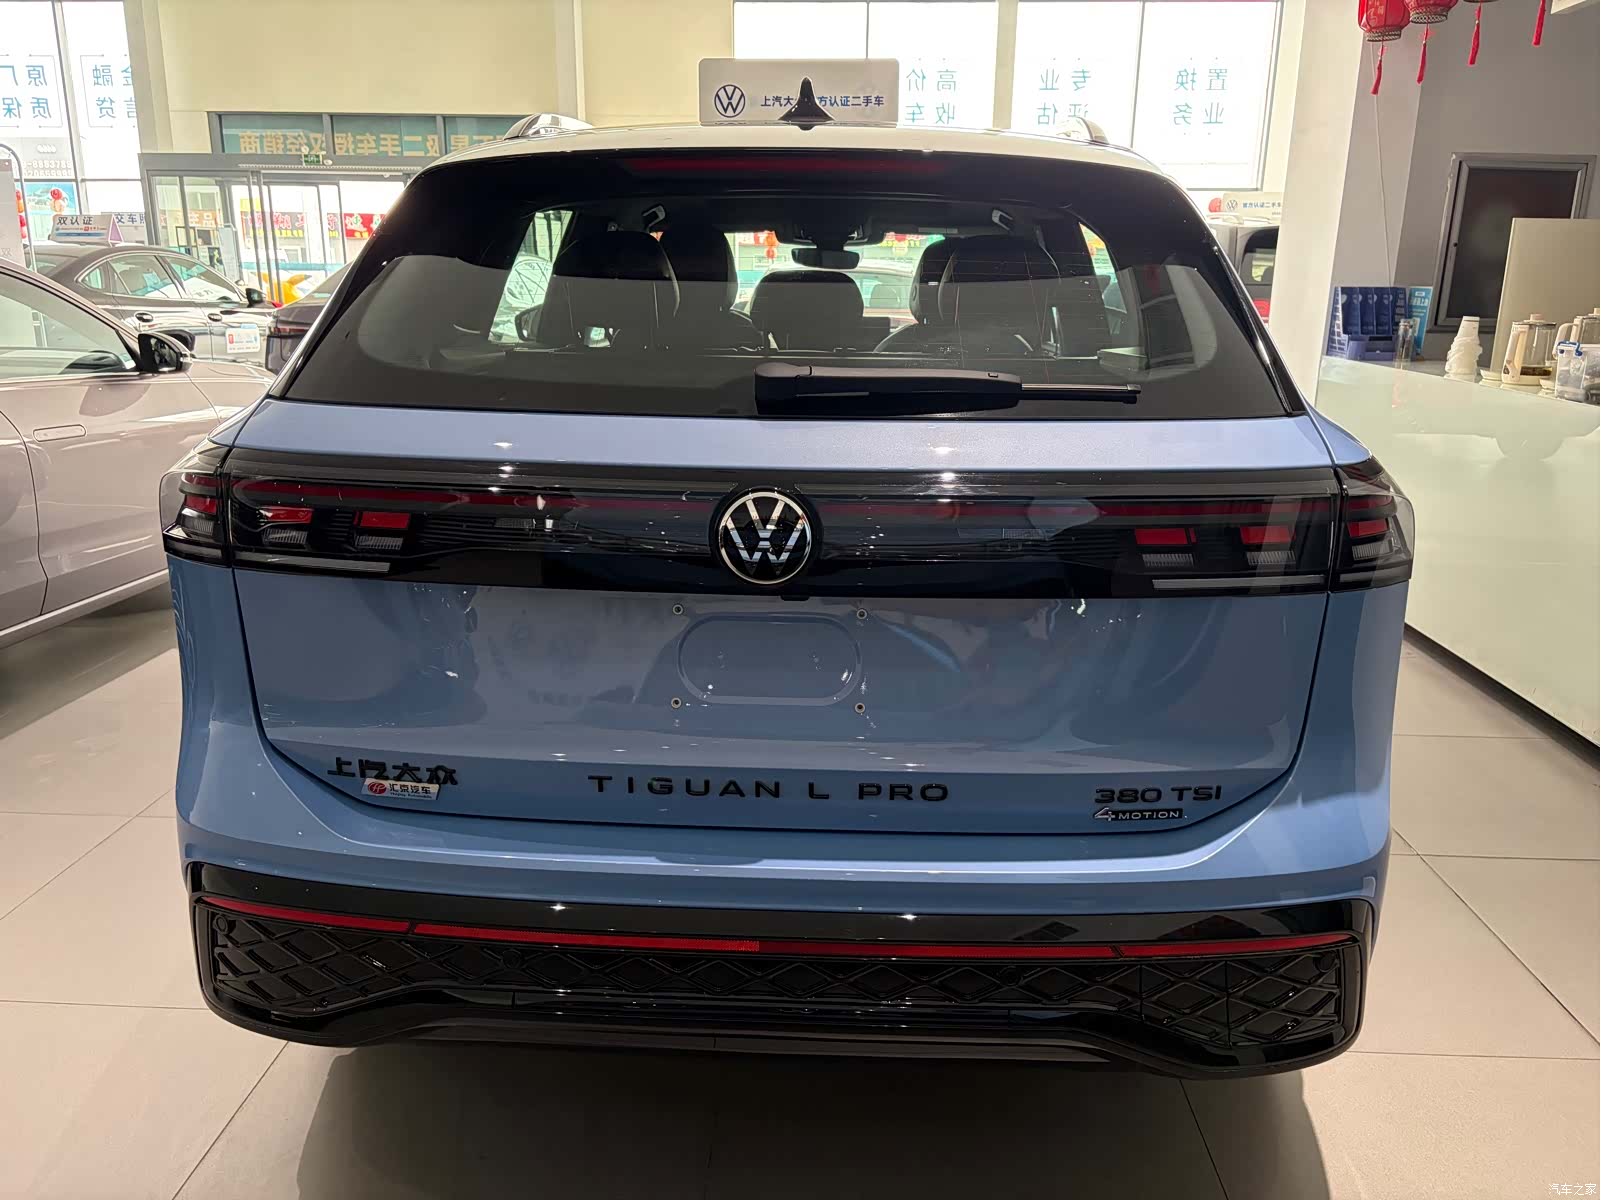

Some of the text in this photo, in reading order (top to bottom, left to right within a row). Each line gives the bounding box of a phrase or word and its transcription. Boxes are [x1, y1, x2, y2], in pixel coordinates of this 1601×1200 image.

[760, 95, 885, 107] 上汽大方认证二手车
[57, 215, 93, 226] 双认证
[327, 756, 459, 786] 上汽大众
[587, 775, 949, 802] TIGUAN L PRO
[1094, 784, 1222, 804] 380 TSI
